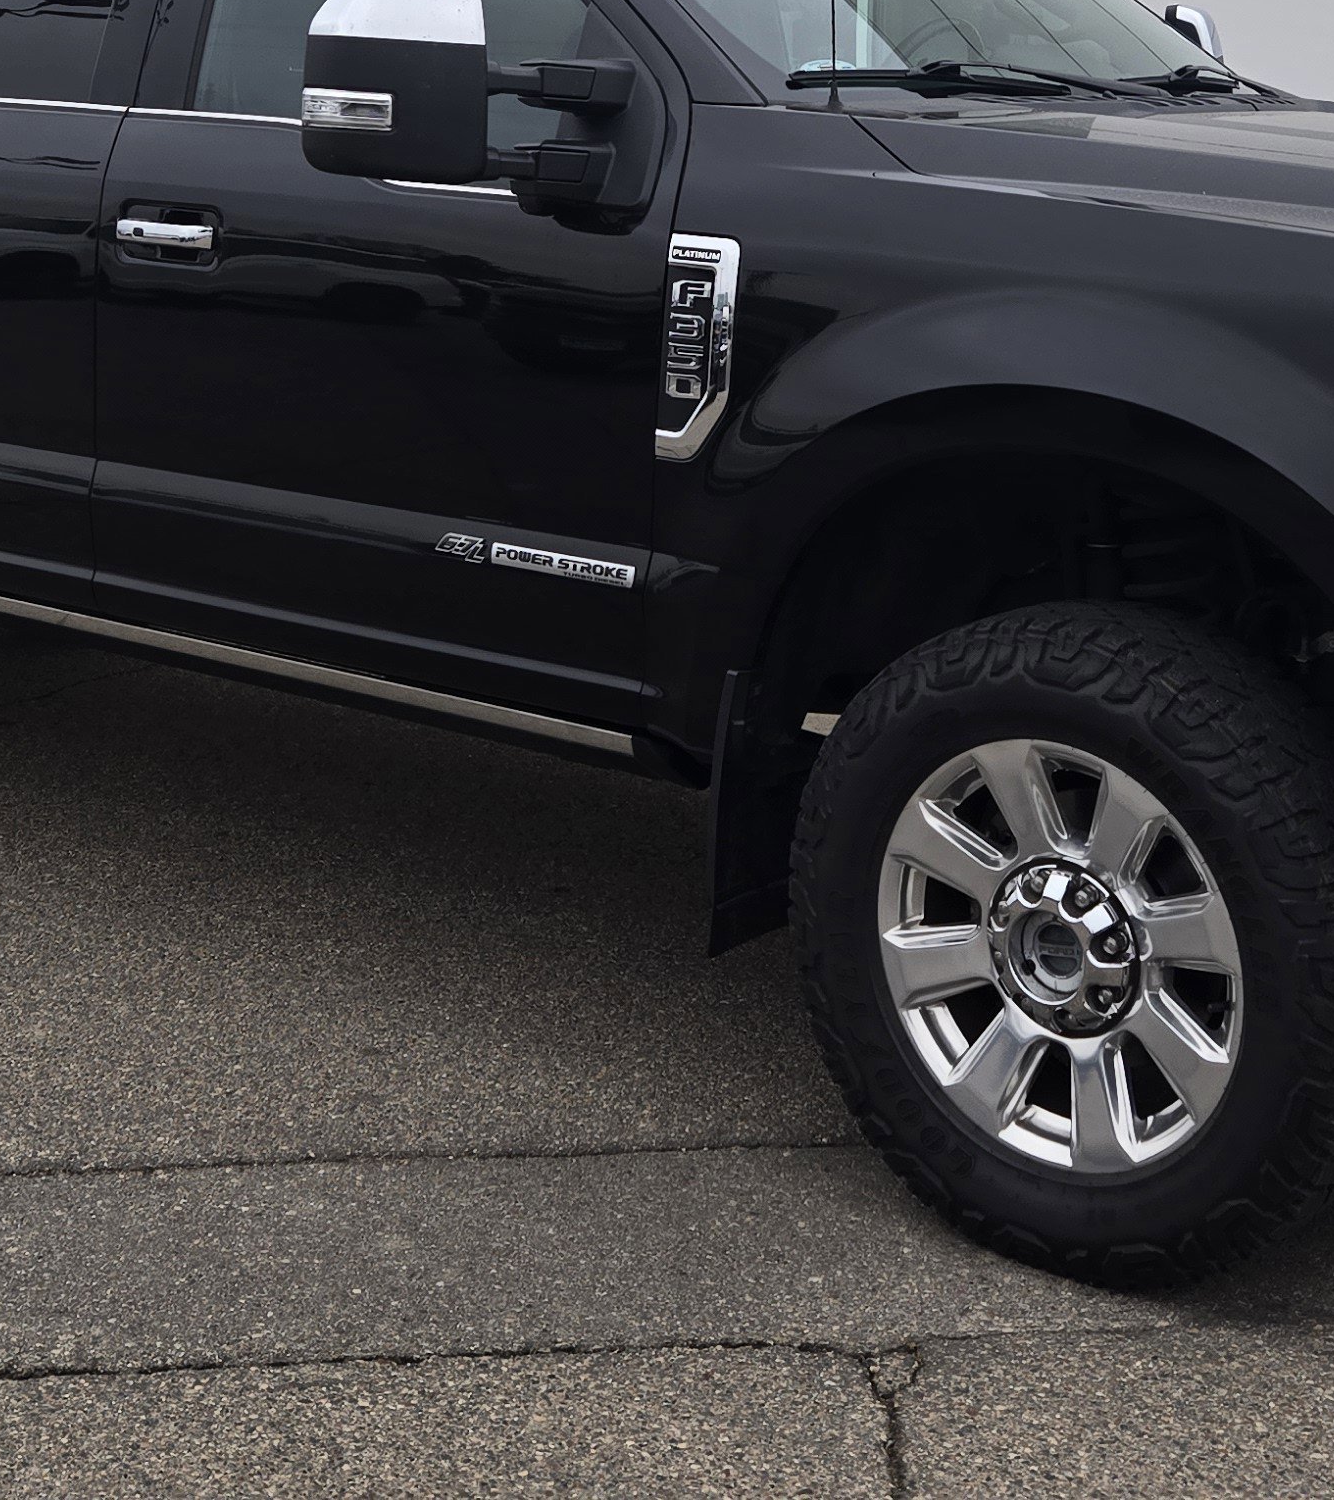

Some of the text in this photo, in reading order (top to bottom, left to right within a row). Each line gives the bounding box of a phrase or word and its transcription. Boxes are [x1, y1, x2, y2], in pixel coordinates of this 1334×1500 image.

[673, 248, 721, 261] PLATINUM
[495, 547, 627, 580] POWER STROKE
